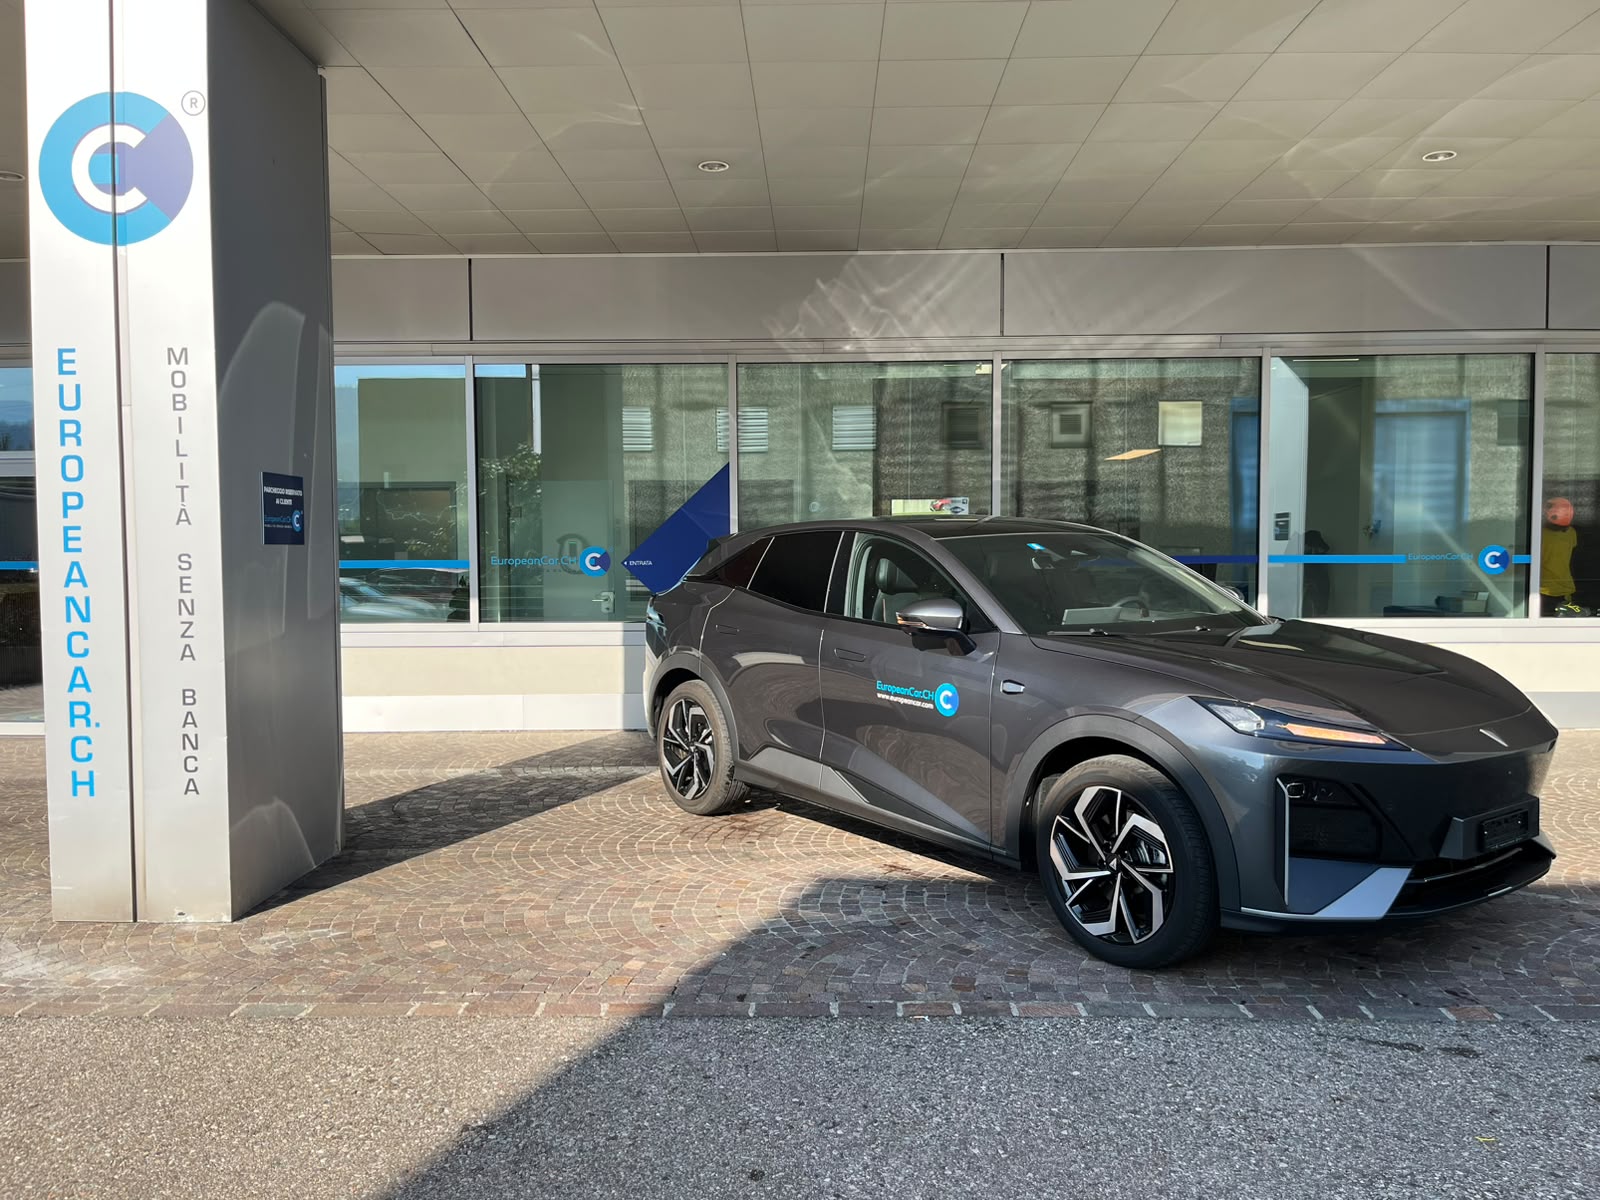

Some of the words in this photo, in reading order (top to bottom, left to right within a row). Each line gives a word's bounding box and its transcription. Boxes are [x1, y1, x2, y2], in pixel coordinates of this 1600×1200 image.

[167, 347, 192, 526] MOBILITÀ
[57, 348, 101, 797] EUROPEANCAR.CH
[177, 553, 196, 661] SENZA
[490, 556, 577, 567] EuropeanCar.CH
[182, 688, 200, 795] BANCA
[876, 680, 935, 701] EuropeanCar.CH
[876, 693, 934, 709] www.europeancar.com
